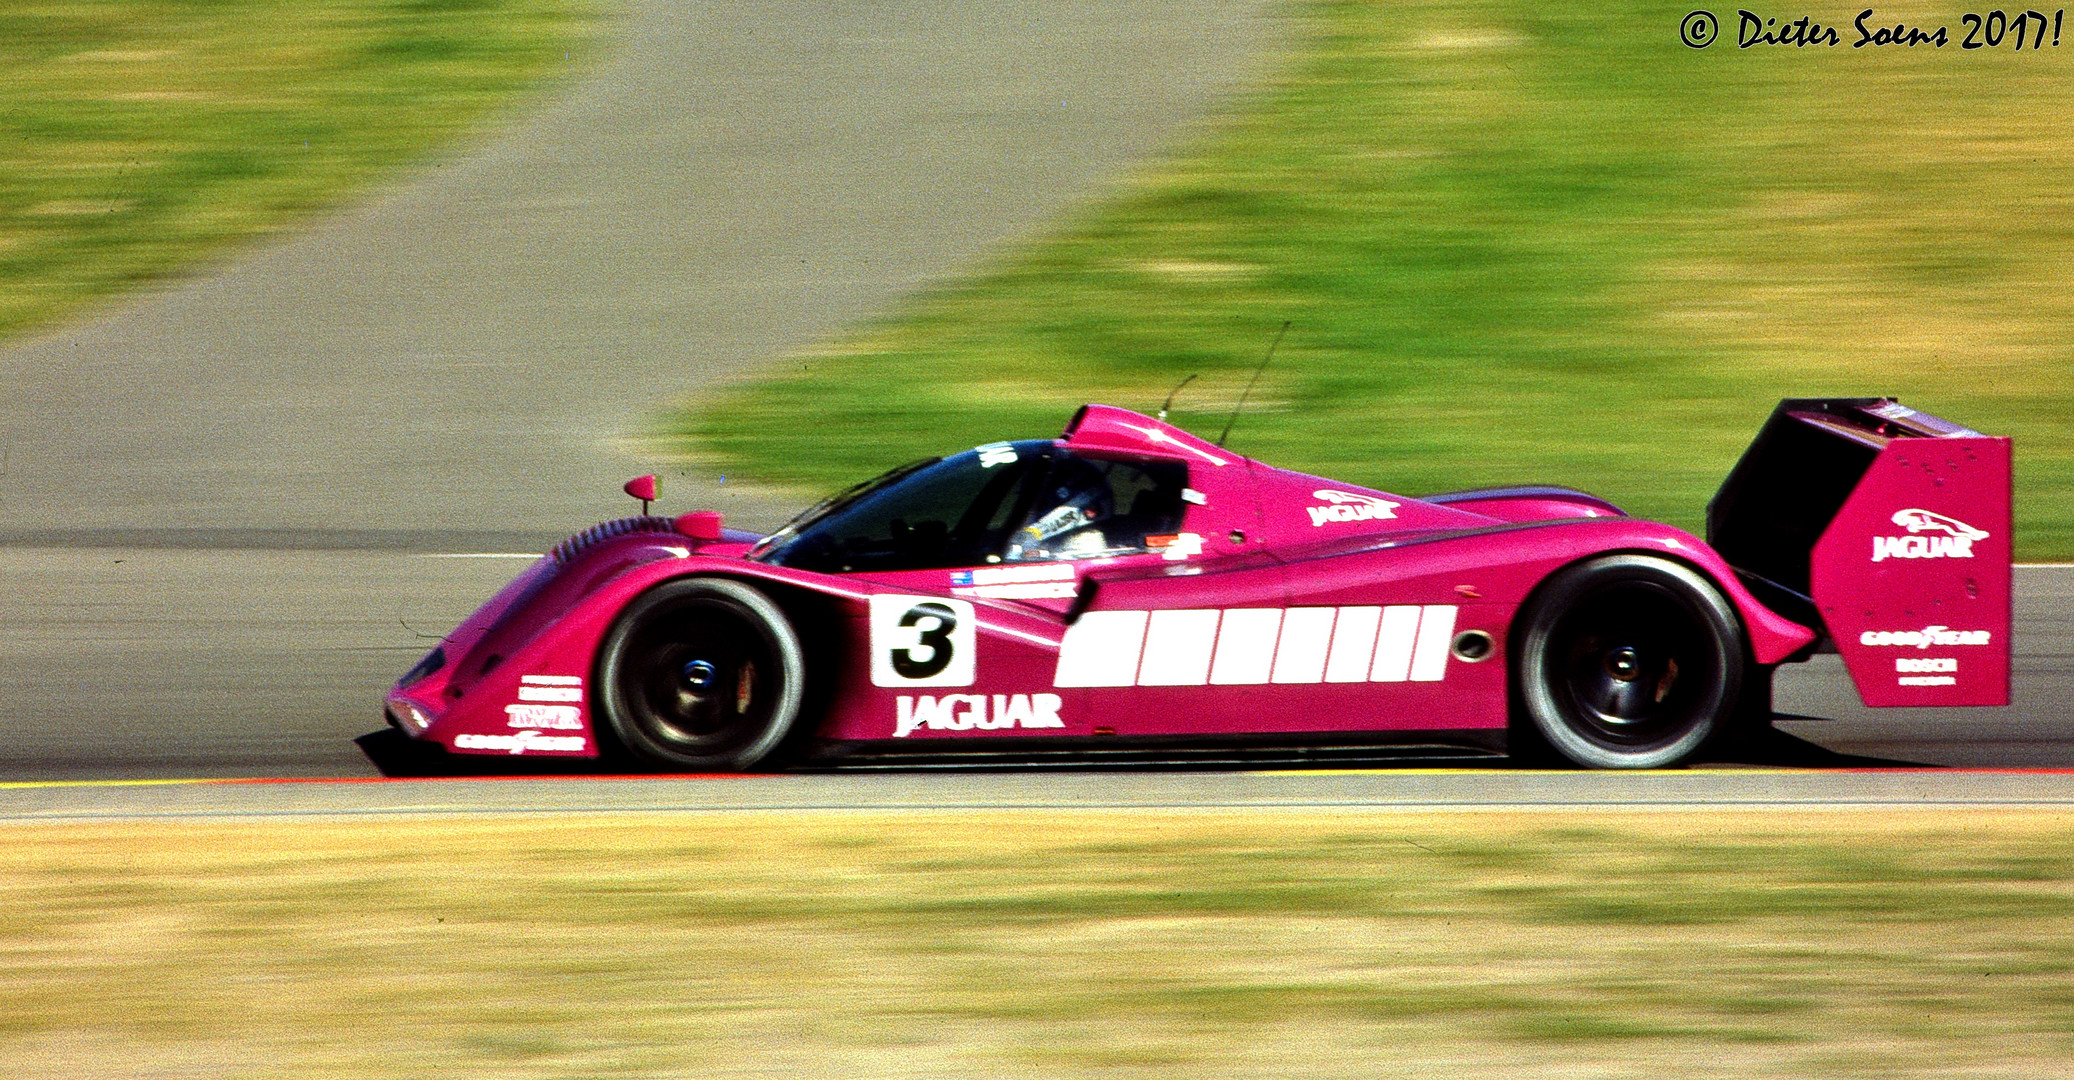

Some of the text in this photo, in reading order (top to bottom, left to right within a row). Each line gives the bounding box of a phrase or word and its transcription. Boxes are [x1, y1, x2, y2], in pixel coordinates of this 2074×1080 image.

[1306, 504, 1398, 527] JAGUAR
[1871, 535, 1974, 562] JAGUAR
[890, 602, 958, 679] 3
[1860, 625, 1990, 649] GOODYEAR
[893, 693, 1065, 737] JAGUAR
